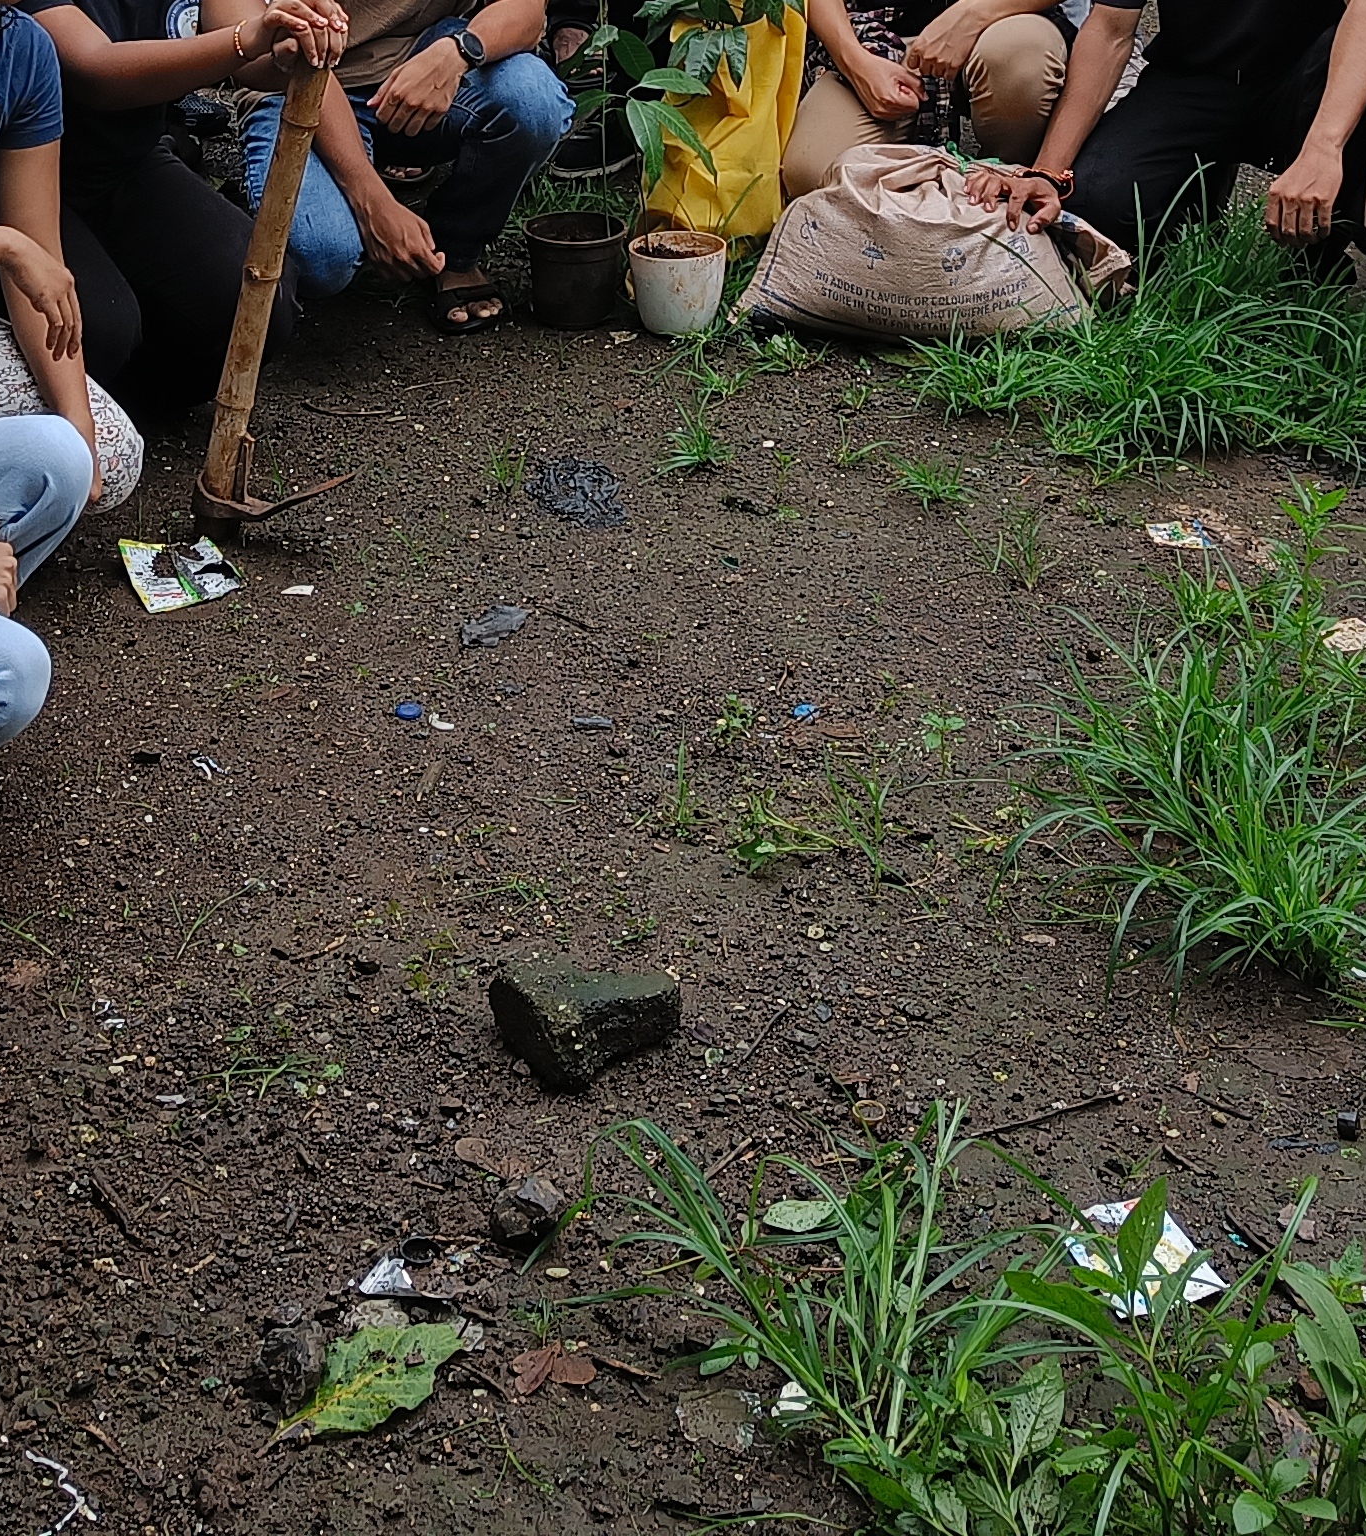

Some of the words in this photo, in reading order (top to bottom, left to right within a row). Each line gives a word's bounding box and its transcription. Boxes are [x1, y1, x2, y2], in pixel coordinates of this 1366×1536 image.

[815, 268, 829, 284] NO
[830, 277, 863, 296] ADDED
[864, 289, 912, 306] FLAVOUR
[914, 296, 929, 306] OR
[821, 286, 852, 307] STORE
[853, 298, 864, 310] IN
[947, 303, 990, 319] HGIENE
